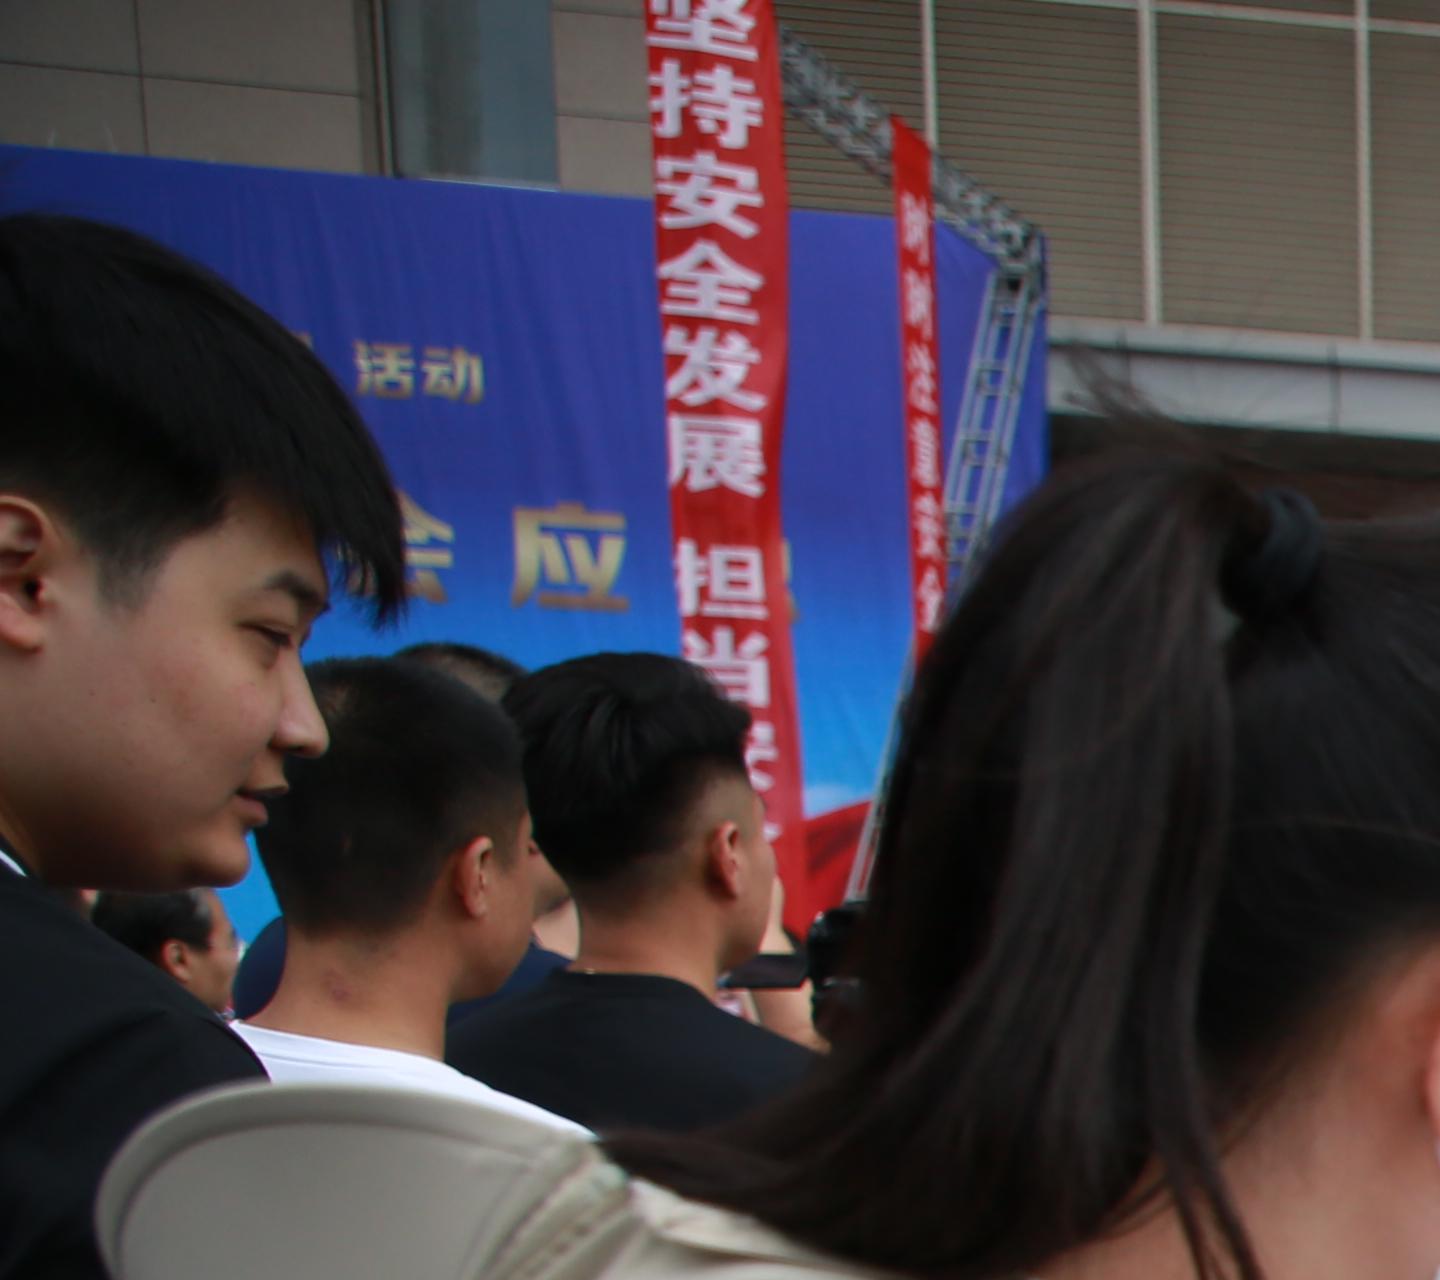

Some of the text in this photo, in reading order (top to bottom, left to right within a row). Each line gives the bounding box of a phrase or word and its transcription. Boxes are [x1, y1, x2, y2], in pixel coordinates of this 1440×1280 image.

[646, 0, 767, 499] 坚持安全发展
